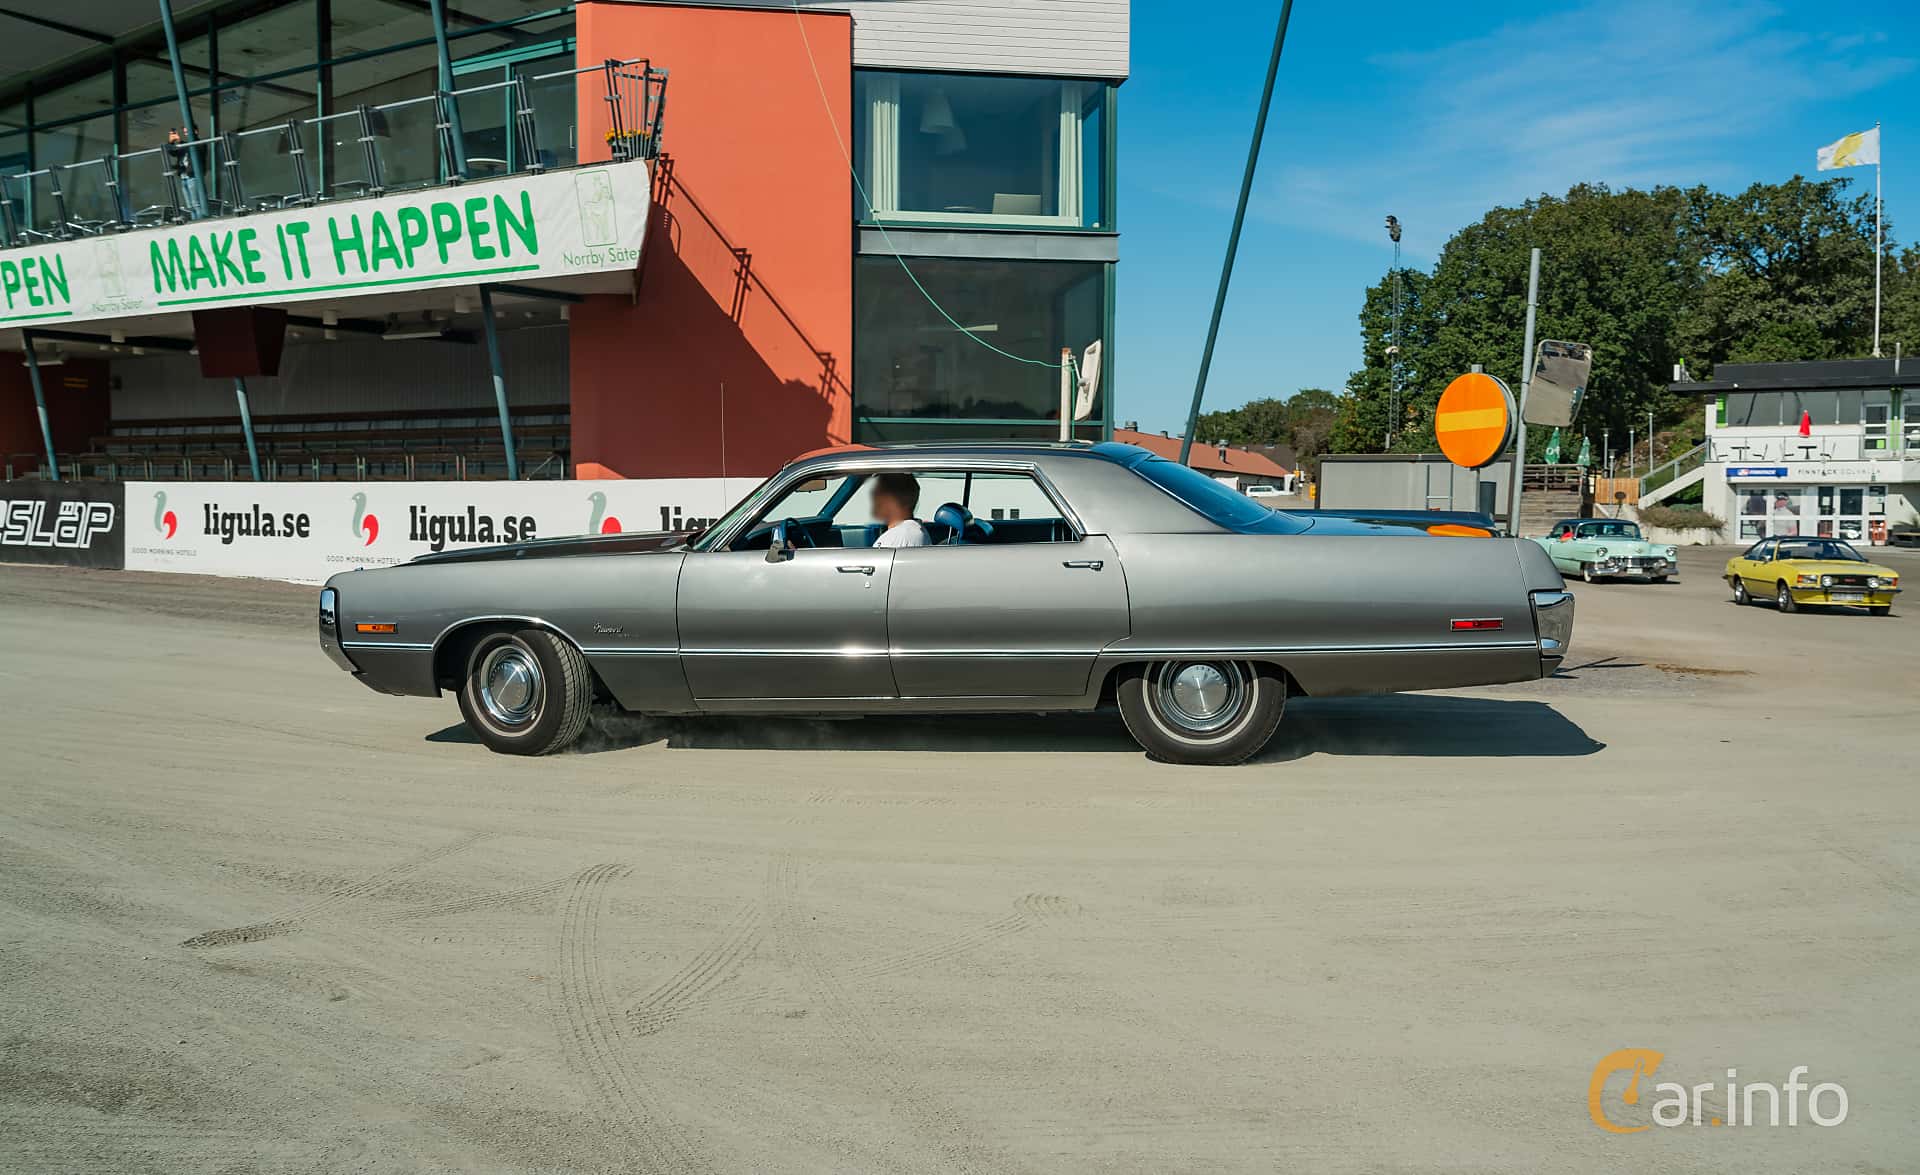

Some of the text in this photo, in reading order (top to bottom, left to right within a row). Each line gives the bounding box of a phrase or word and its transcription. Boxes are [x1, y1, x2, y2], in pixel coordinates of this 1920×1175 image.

[149, 190, 539, 293] MAKE IT HAPPEN
[563, 248, 604, 268] Norrby
[0, 253, 71, 310] PEN
[204, 503, 310, 545] ligula.se
[409, 505, 536, 551] ligula.se
